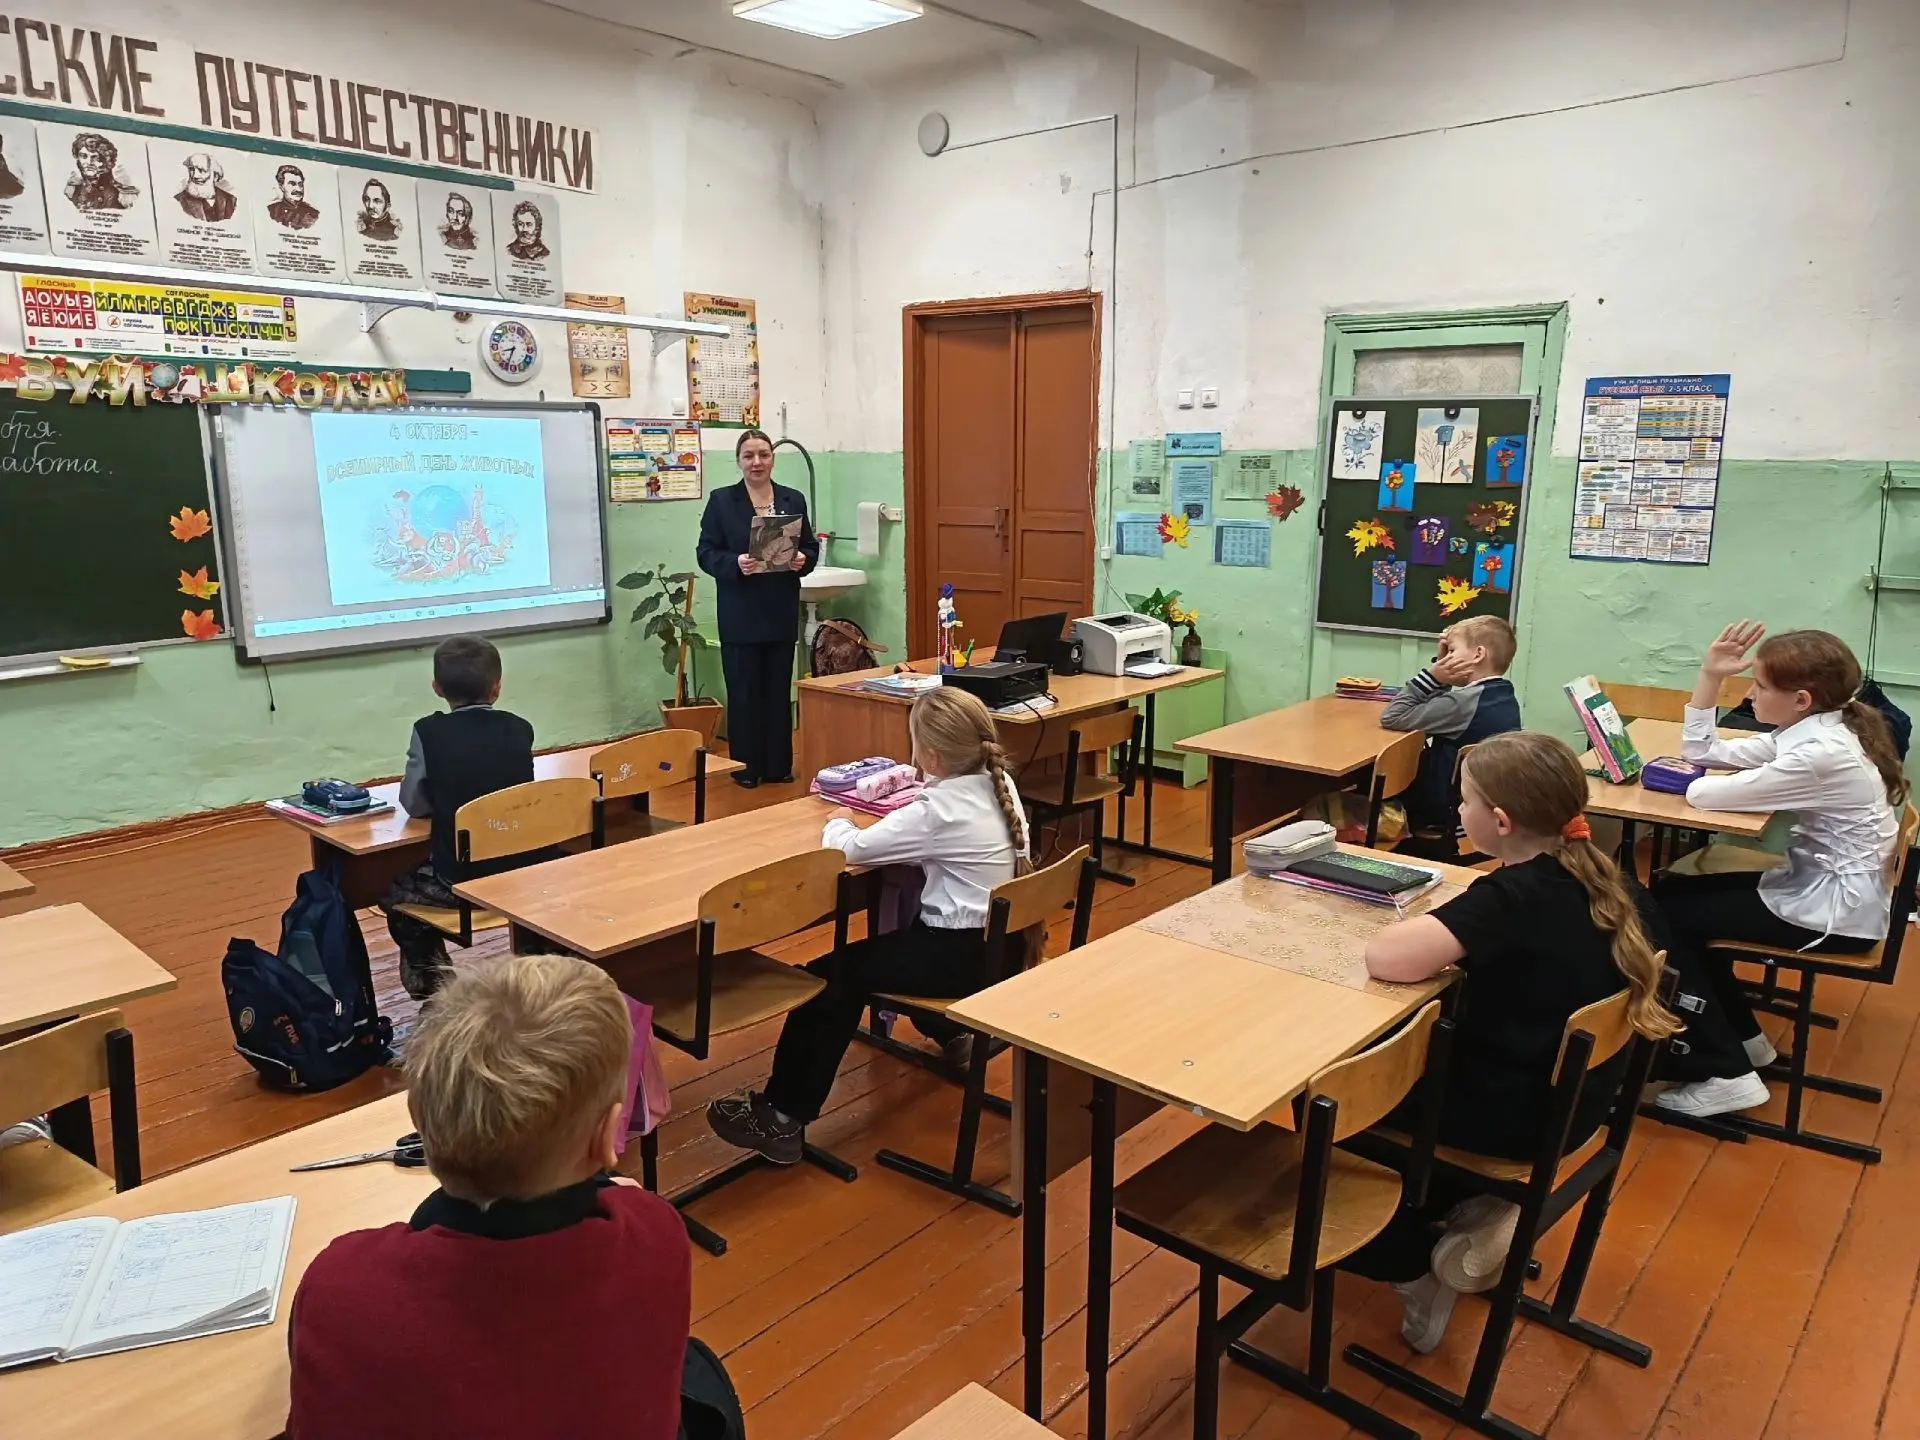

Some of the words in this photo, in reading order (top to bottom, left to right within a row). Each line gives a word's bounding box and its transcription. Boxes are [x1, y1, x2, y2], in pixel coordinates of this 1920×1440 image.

[195, 52, 593, 190] ПУТЕШЕСТВЕННИКИ
[326, 451, 416, 484] ВСЕМИРНЫЙ
[419, 454, 458, 474] ДЕНЬ
